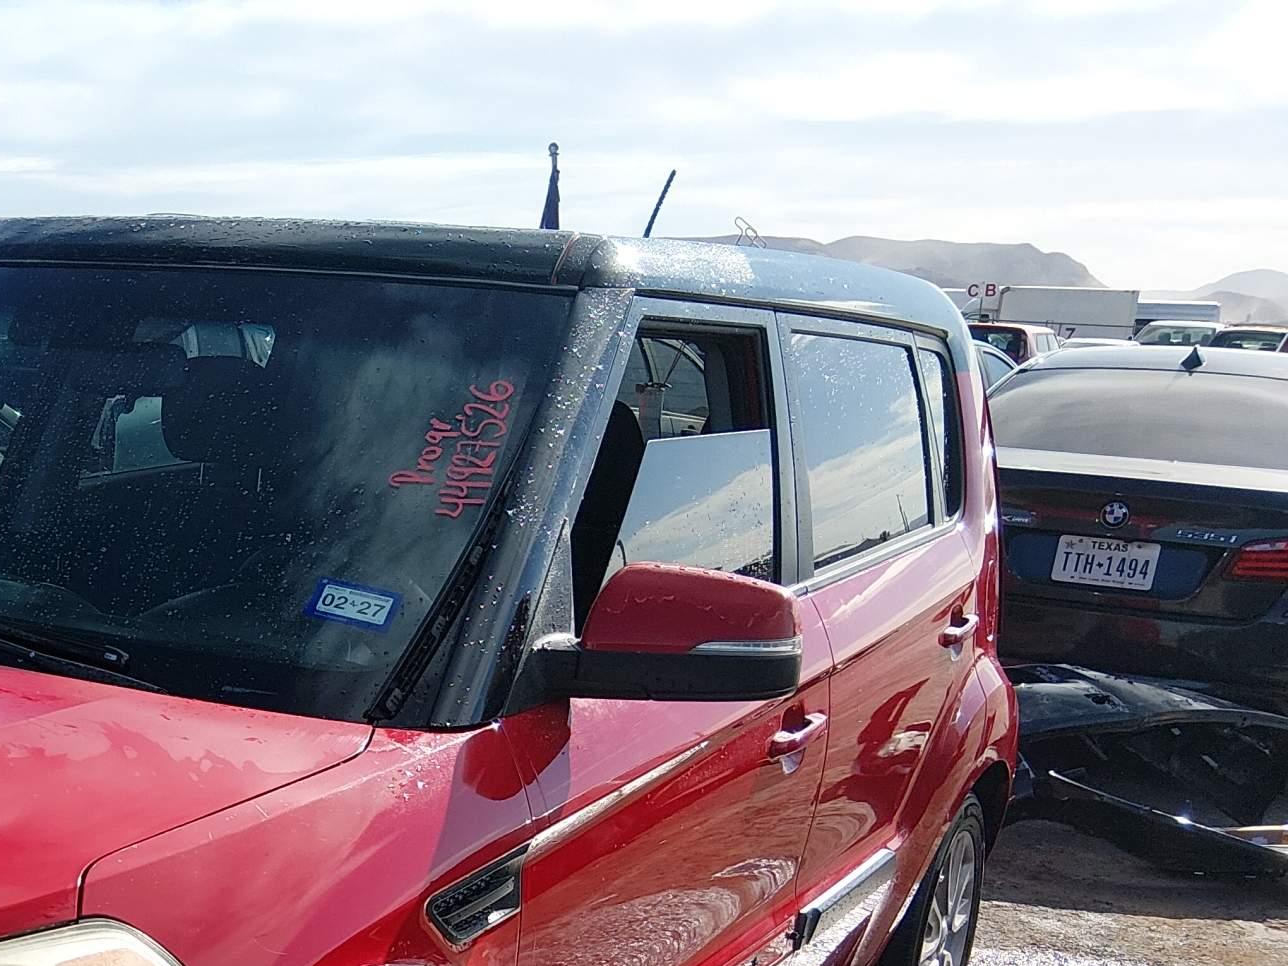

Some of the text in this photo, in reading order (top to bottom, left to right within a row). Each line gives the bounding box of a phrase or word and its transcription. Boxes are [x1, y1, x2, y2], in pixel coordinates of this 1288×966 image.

[968, 284, 979, 297] C
[985, 284, 997, 297] B
[1091, 540, 1129, 553] TEXAS
[1062, 551, 1150, 580] TTH 1494
[321, 593, 348, 610] 02
[356, 600, 386, 618] 27
